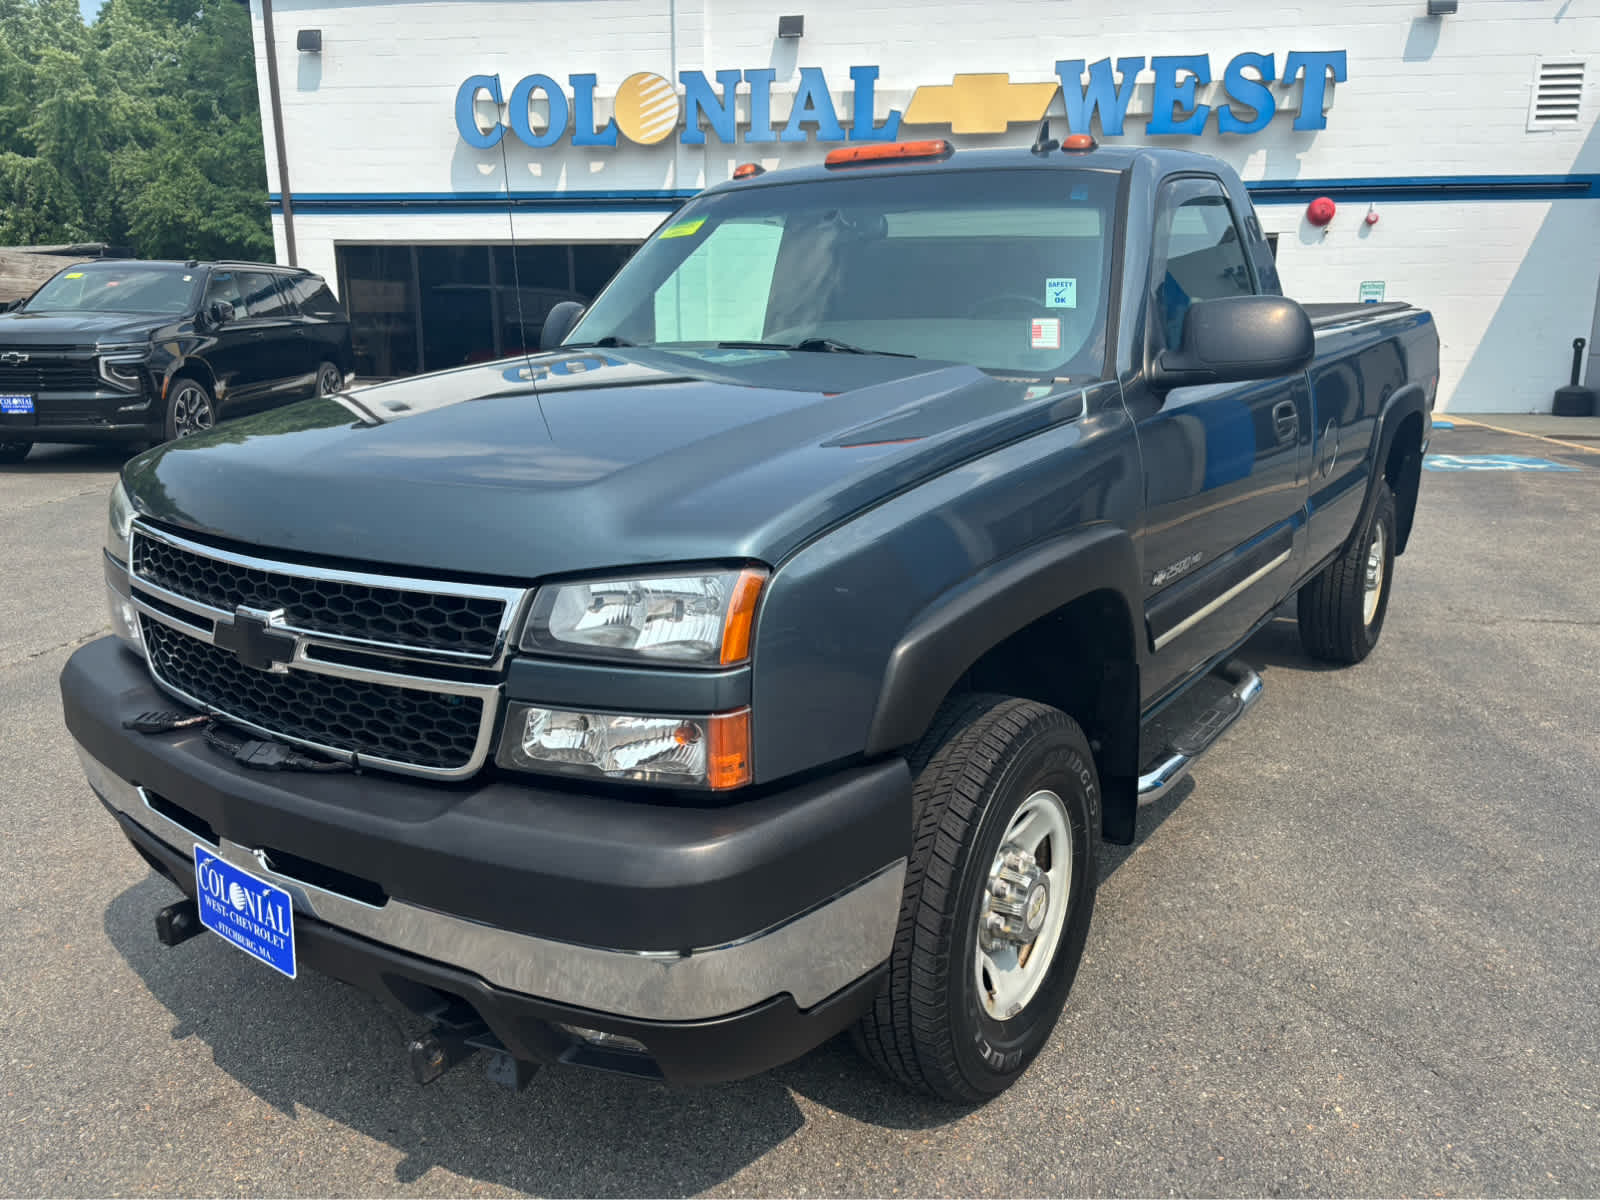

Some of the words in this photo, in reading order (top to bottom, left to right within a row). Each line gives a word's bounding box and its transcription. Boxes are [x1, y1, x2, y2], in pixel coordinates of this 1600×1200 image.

[455, 66, 901, 149] COLONIAL
[1055, 50, 1348, 137] WEST
[1054, 296, 1067, 304] OK
[198, 862, 290, 937] COLONIAL
[229, 911, 285, 950] CHEVROLET
